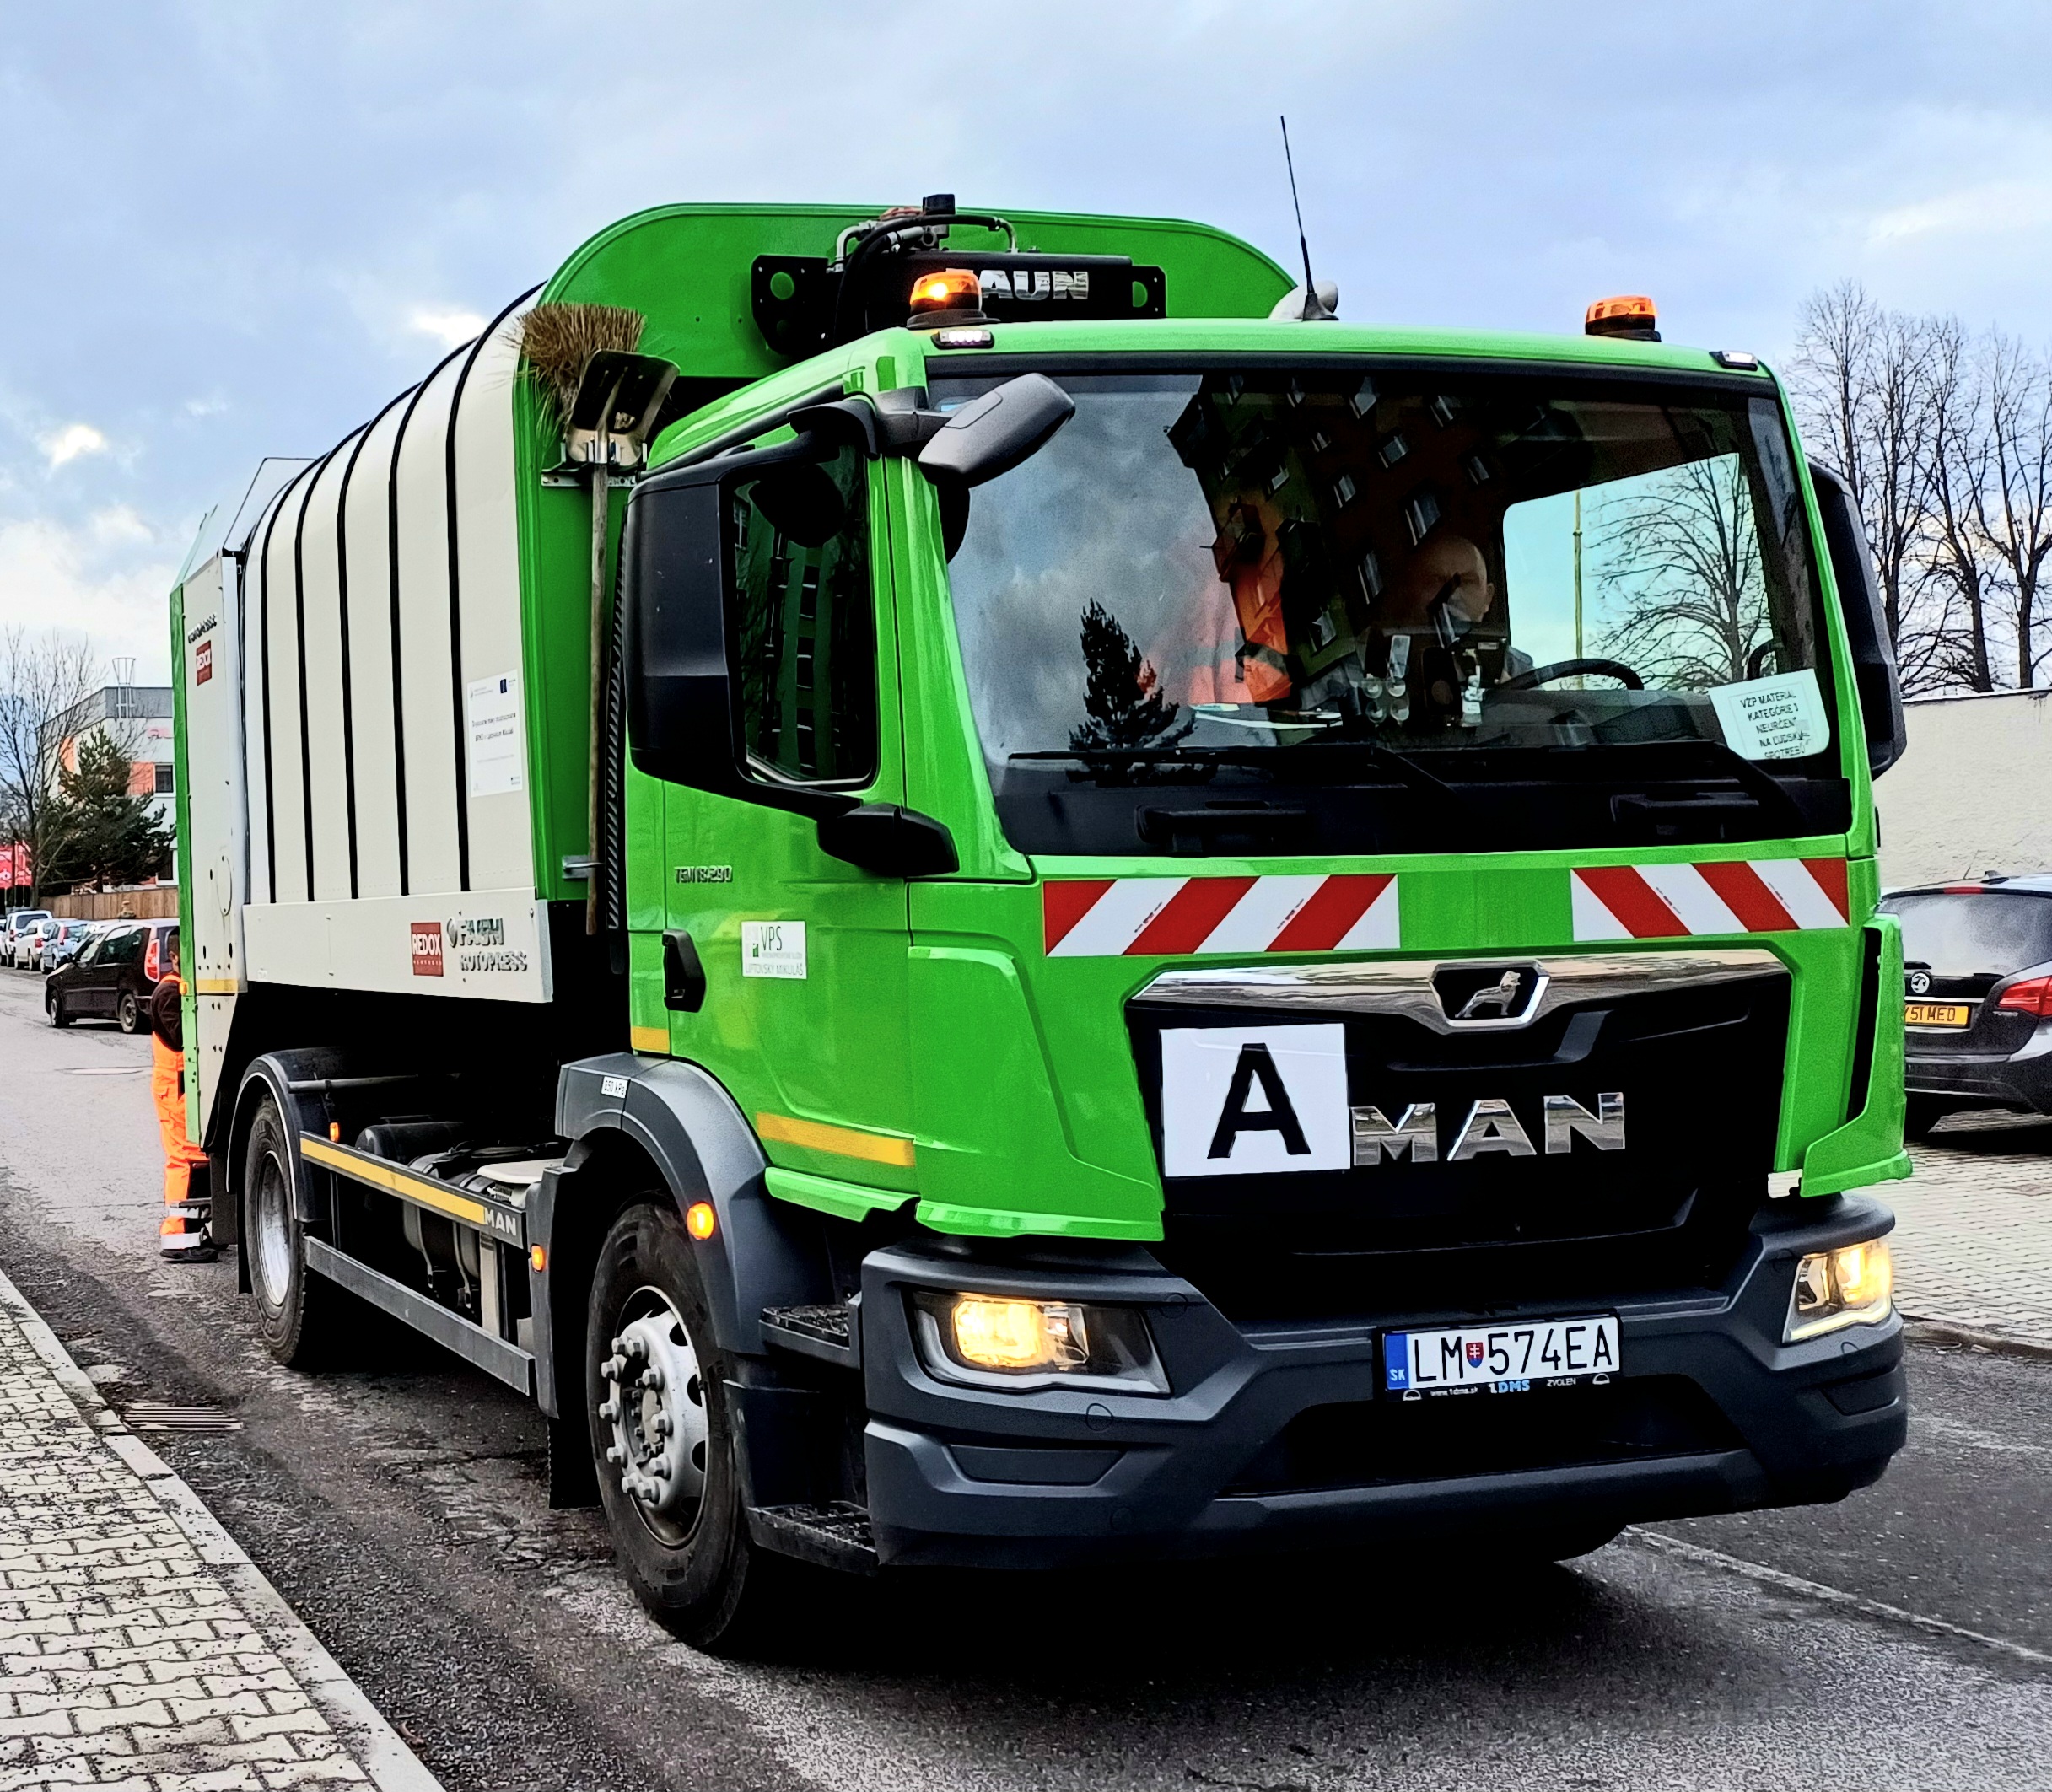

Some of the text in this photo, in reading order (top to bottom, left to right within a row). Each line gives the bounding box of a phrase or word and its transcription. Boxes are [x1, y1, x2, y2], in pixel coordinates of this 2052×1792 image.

[978, 270, 1089, 300] AUN
[1758, 738, 1772, 747] NA
[412, 933, 442, 955] REDOX
[761, 926, 783, 951] VPS
[1927, 1007, 1956, 1021] MED
[1207, 1042, 1312, 1159] A
[1352, 1092, 1625, 1167] MAN
[484, 1207, 517, 1236] MAN
[1389, 1369, 1406, 1381] SK
[1488, 1380, 1531, 1394] 1DMS
[1547, 1377, 1577, 1387] ZVOLEN
